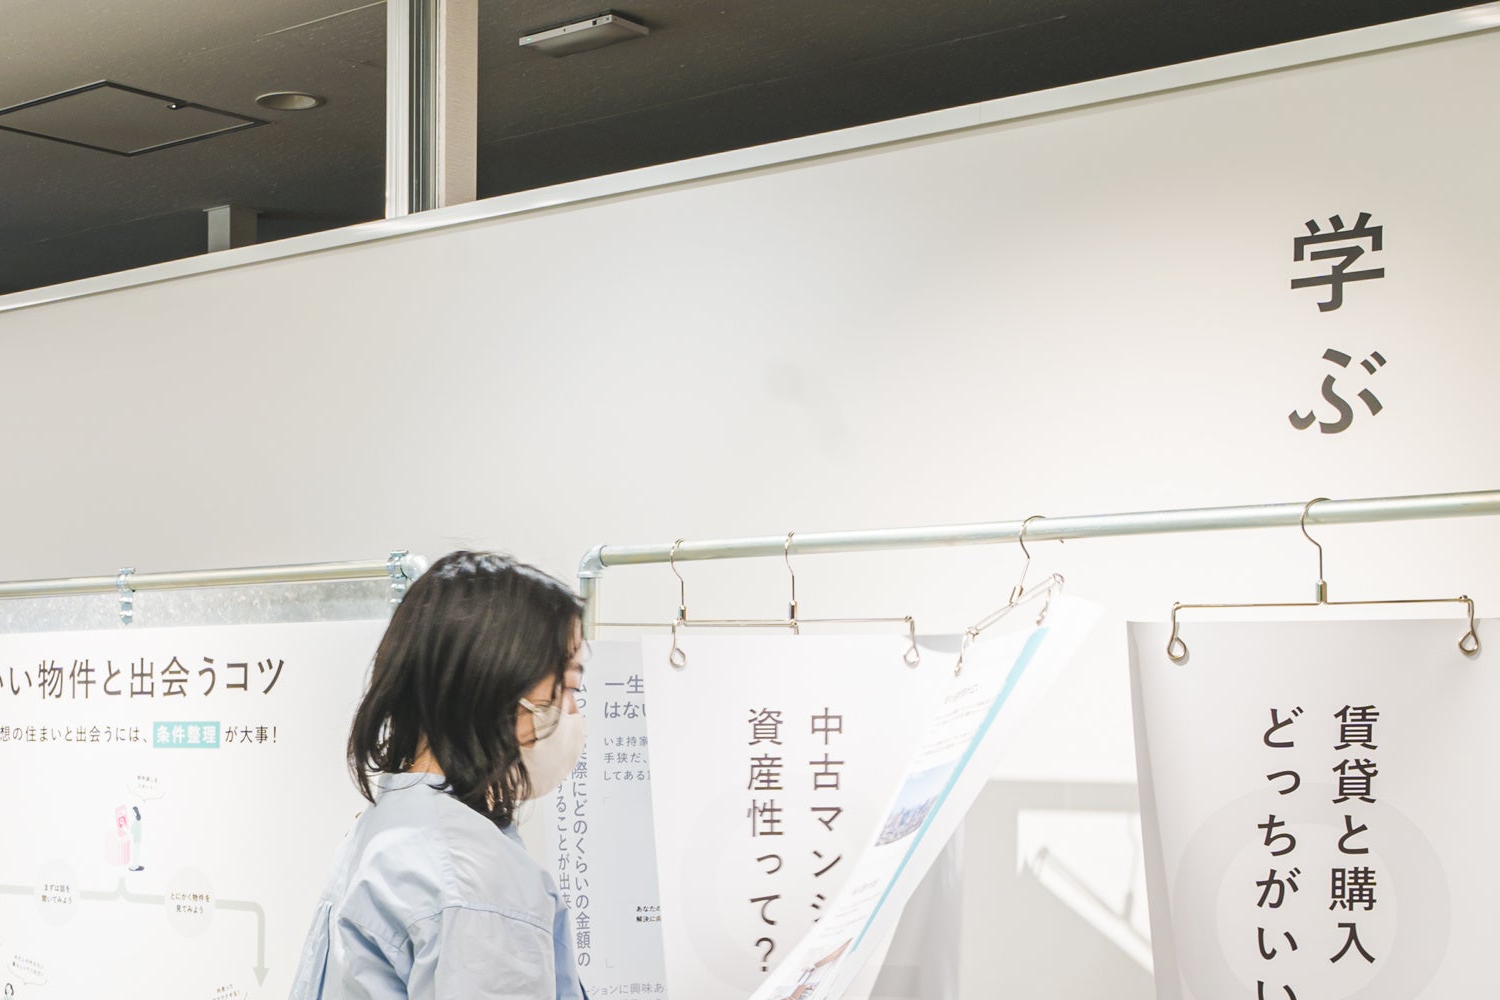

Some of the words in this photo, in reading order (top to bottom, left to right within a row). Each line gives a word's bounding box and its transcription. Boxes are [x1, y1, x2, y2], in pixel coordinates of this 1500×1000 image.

[1288, 211, 1387, 434] 学ぶ
[156, 725, 217, 745] 条件整理
[603, 770, 651, 781] してある
[747, 708, 784, 973] 資産性って？
[1328, 704, 1380, 964] 賃貸と購入
